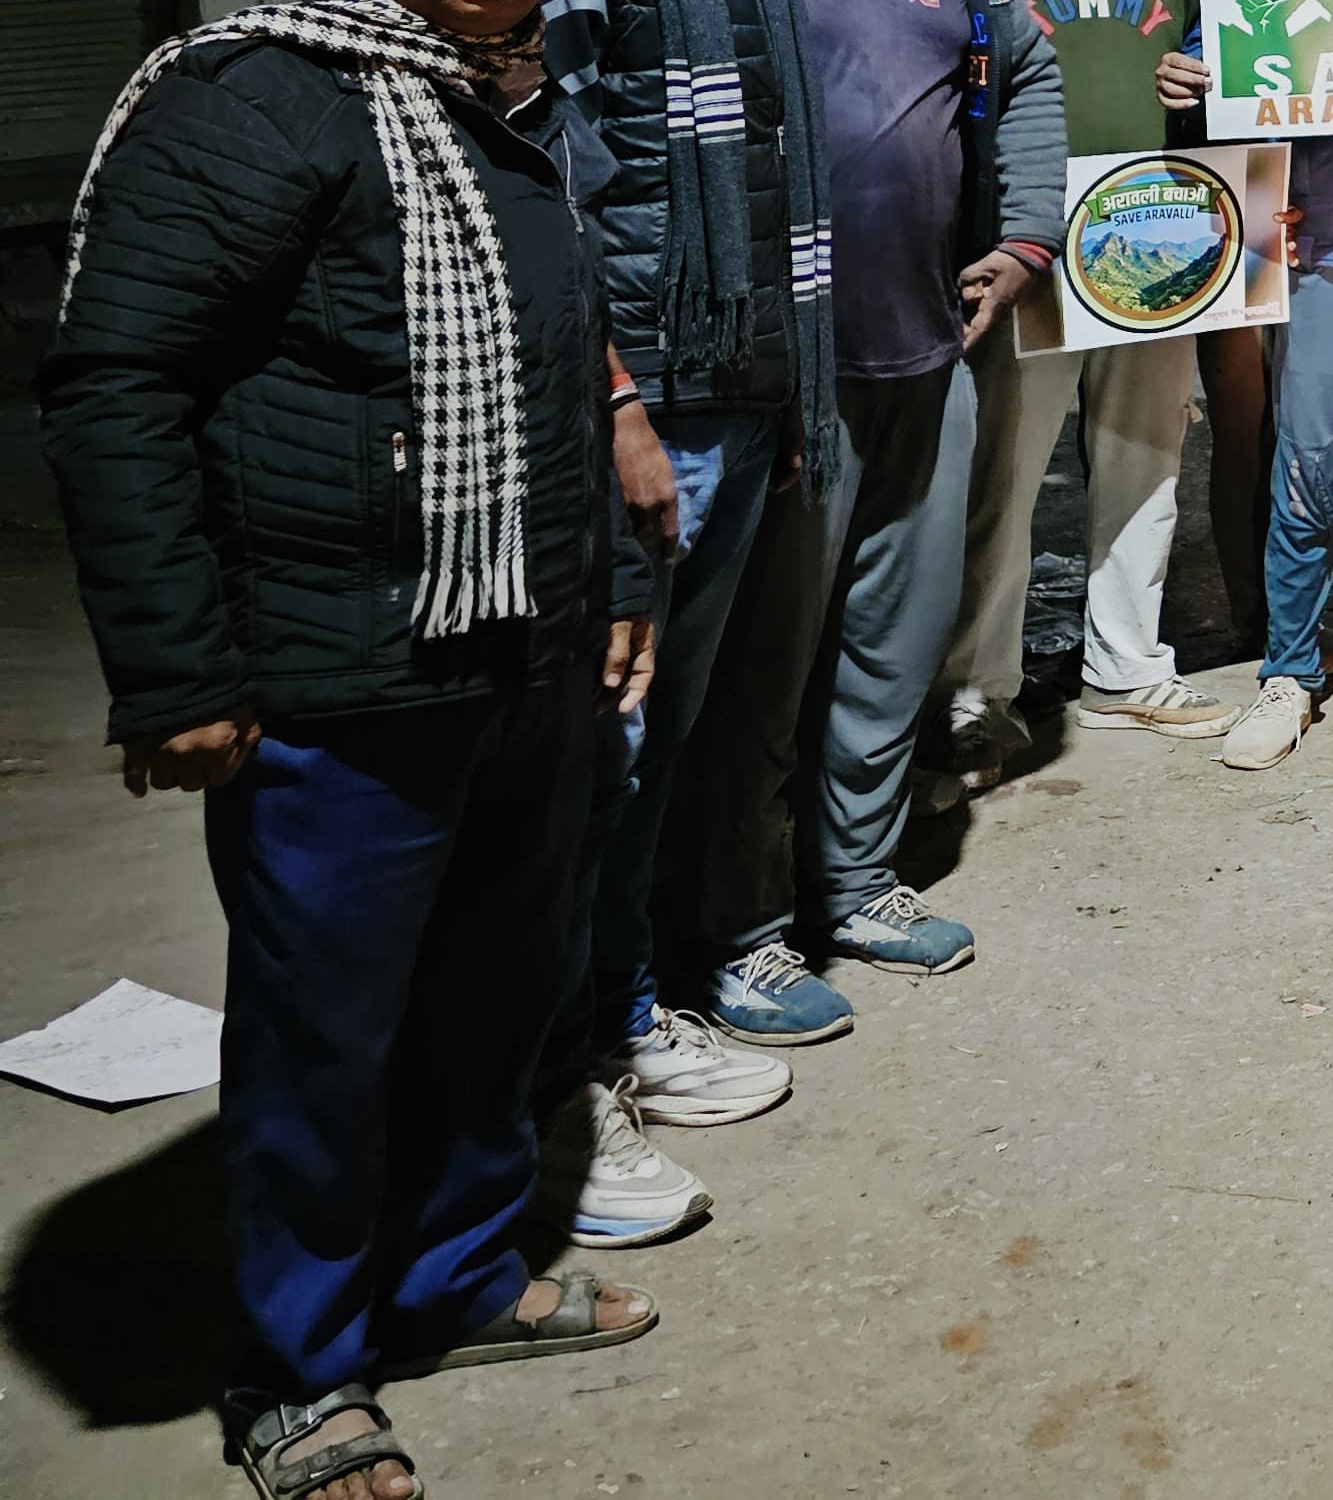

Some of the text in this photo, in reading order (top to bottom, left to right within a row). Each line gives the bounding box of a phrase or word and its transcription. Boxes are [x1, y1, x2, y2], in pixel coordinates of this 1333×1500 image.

[1102, 183, 1209, 213] अरावली बचाओ
[1114, 207, 1195, 227] SAVE ARAVALLI
